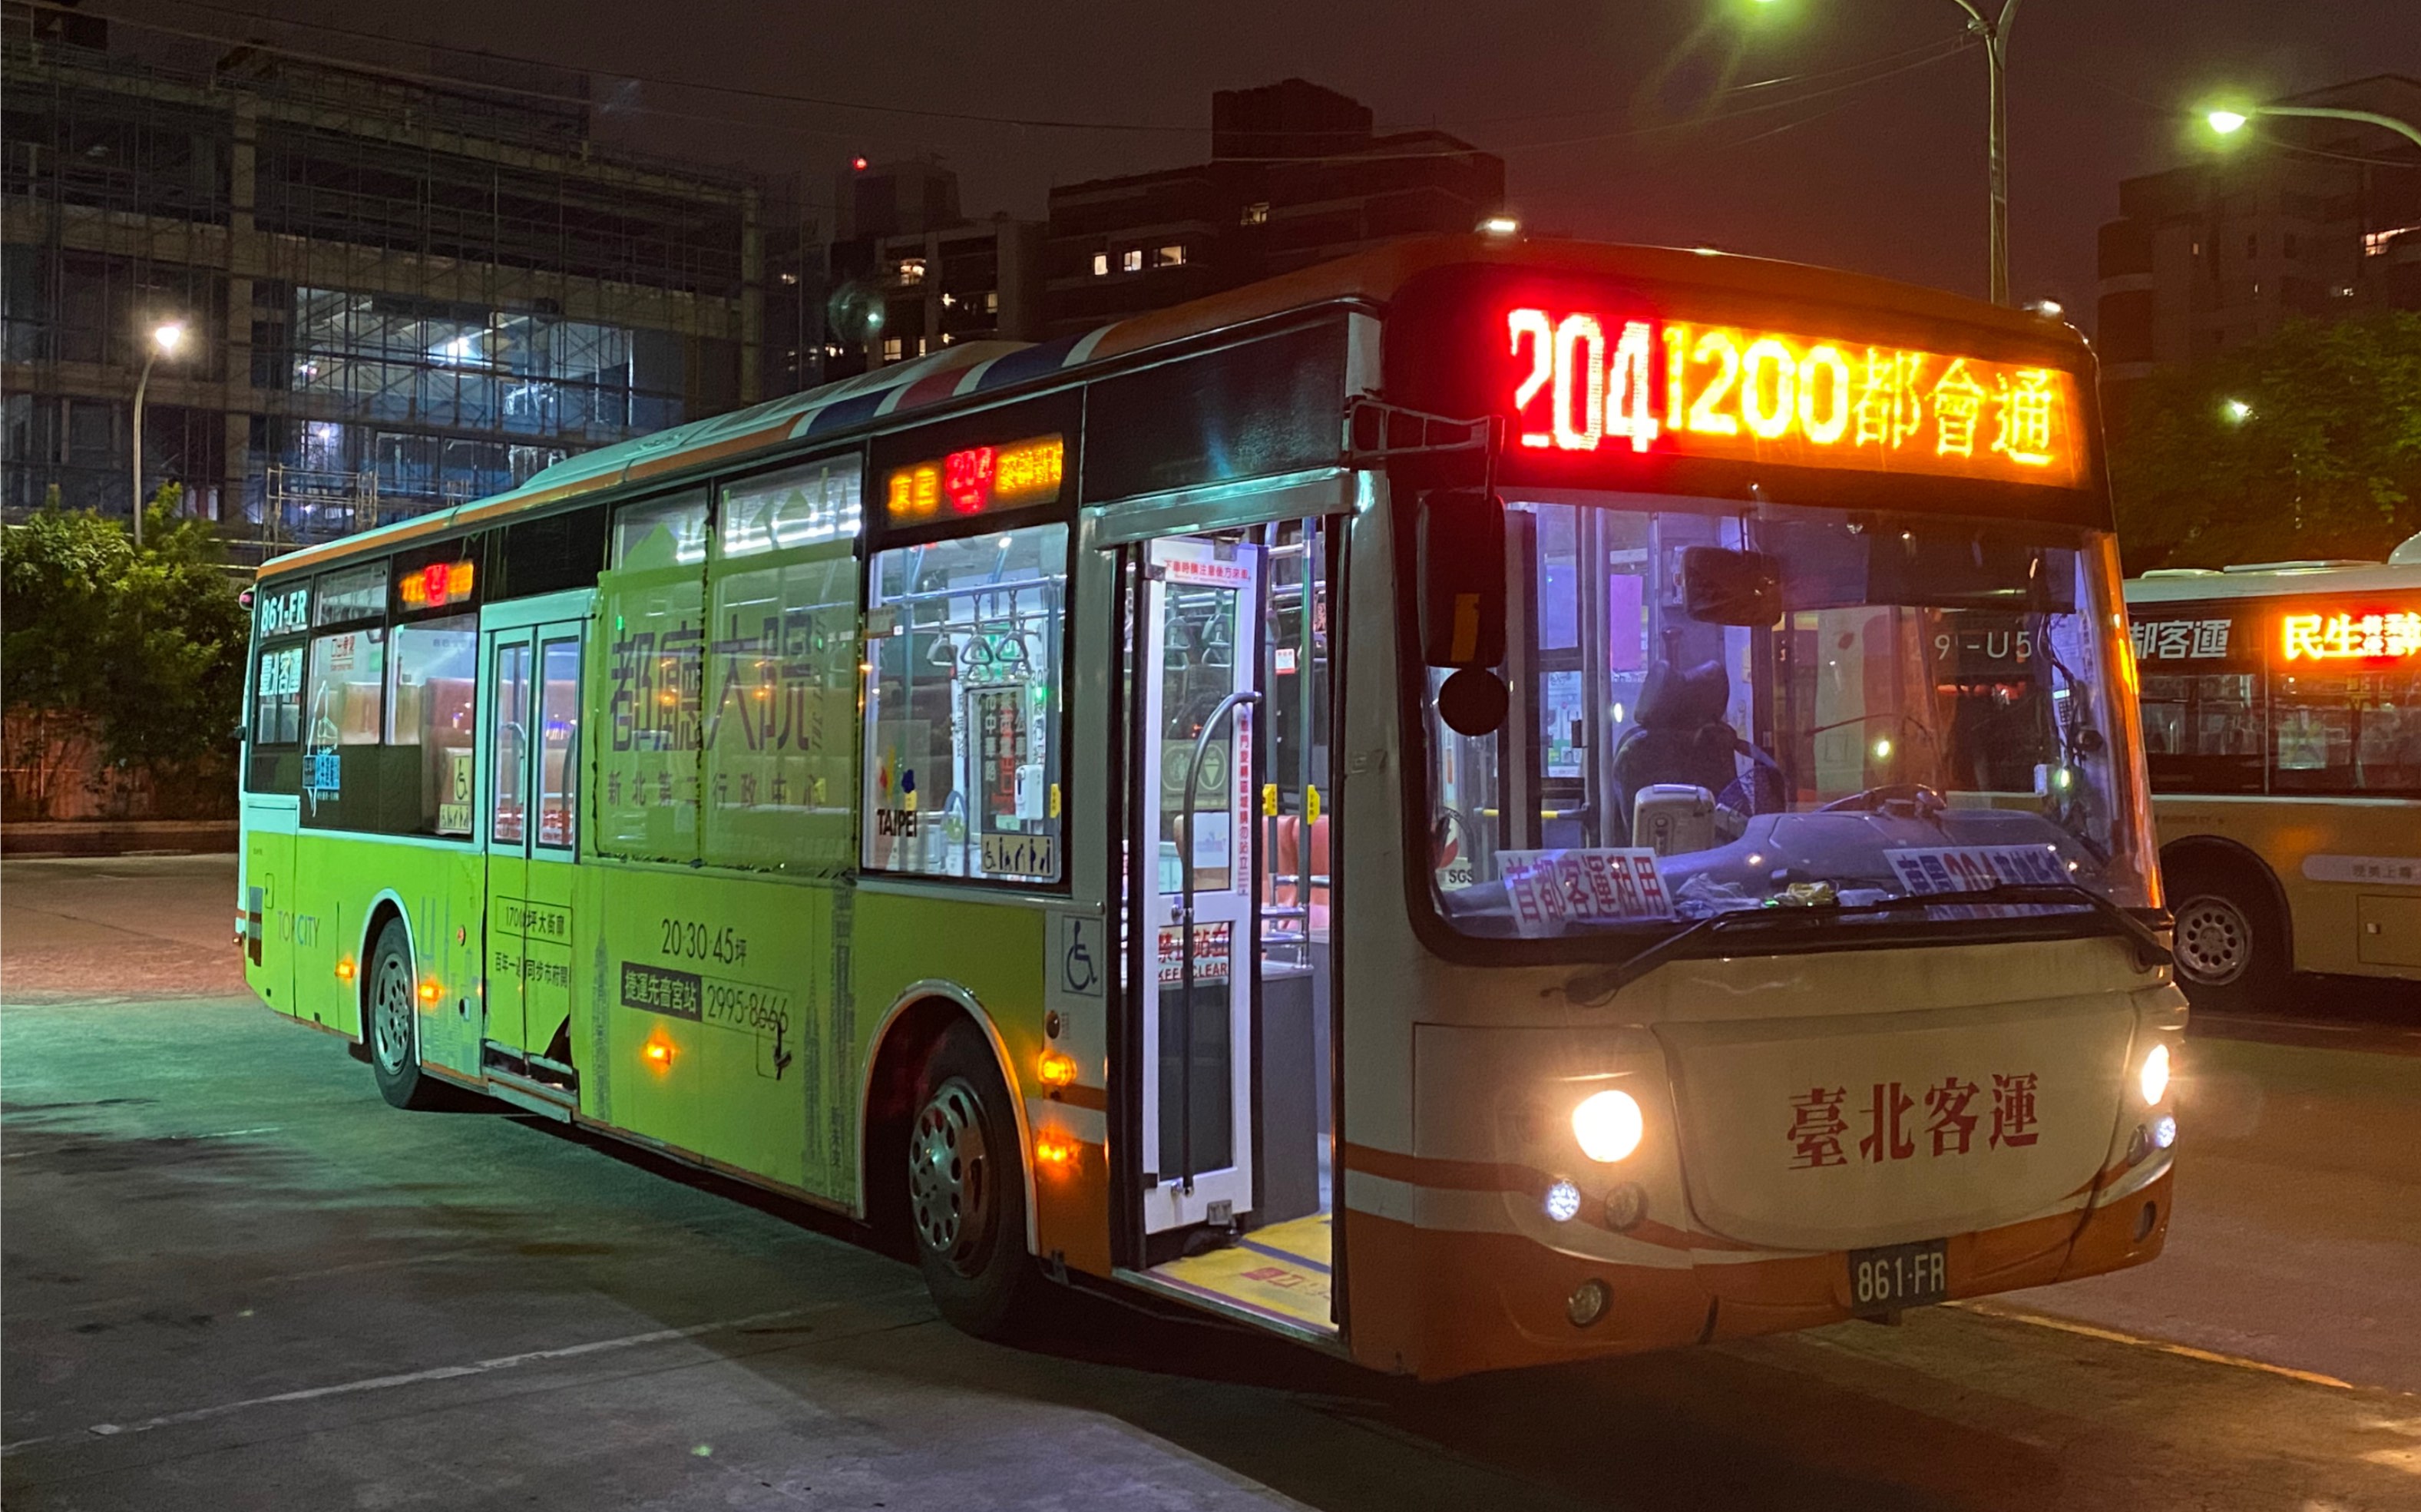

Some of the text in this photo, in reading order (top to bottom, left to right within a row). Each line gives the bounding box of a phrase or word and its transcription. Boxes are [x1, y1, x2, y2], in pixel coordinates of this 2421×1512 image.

[1507, 309, 1659, 453] 204
[261, 589, 308, 632] 861-FR
[877, 809, 918, 838] TAIPEI
[1448, 869, 1473, 883] SGS
[706, 984, 790, 1035] 2995-8666
[1786, 1072, 2039, 1170] 臺北客運
